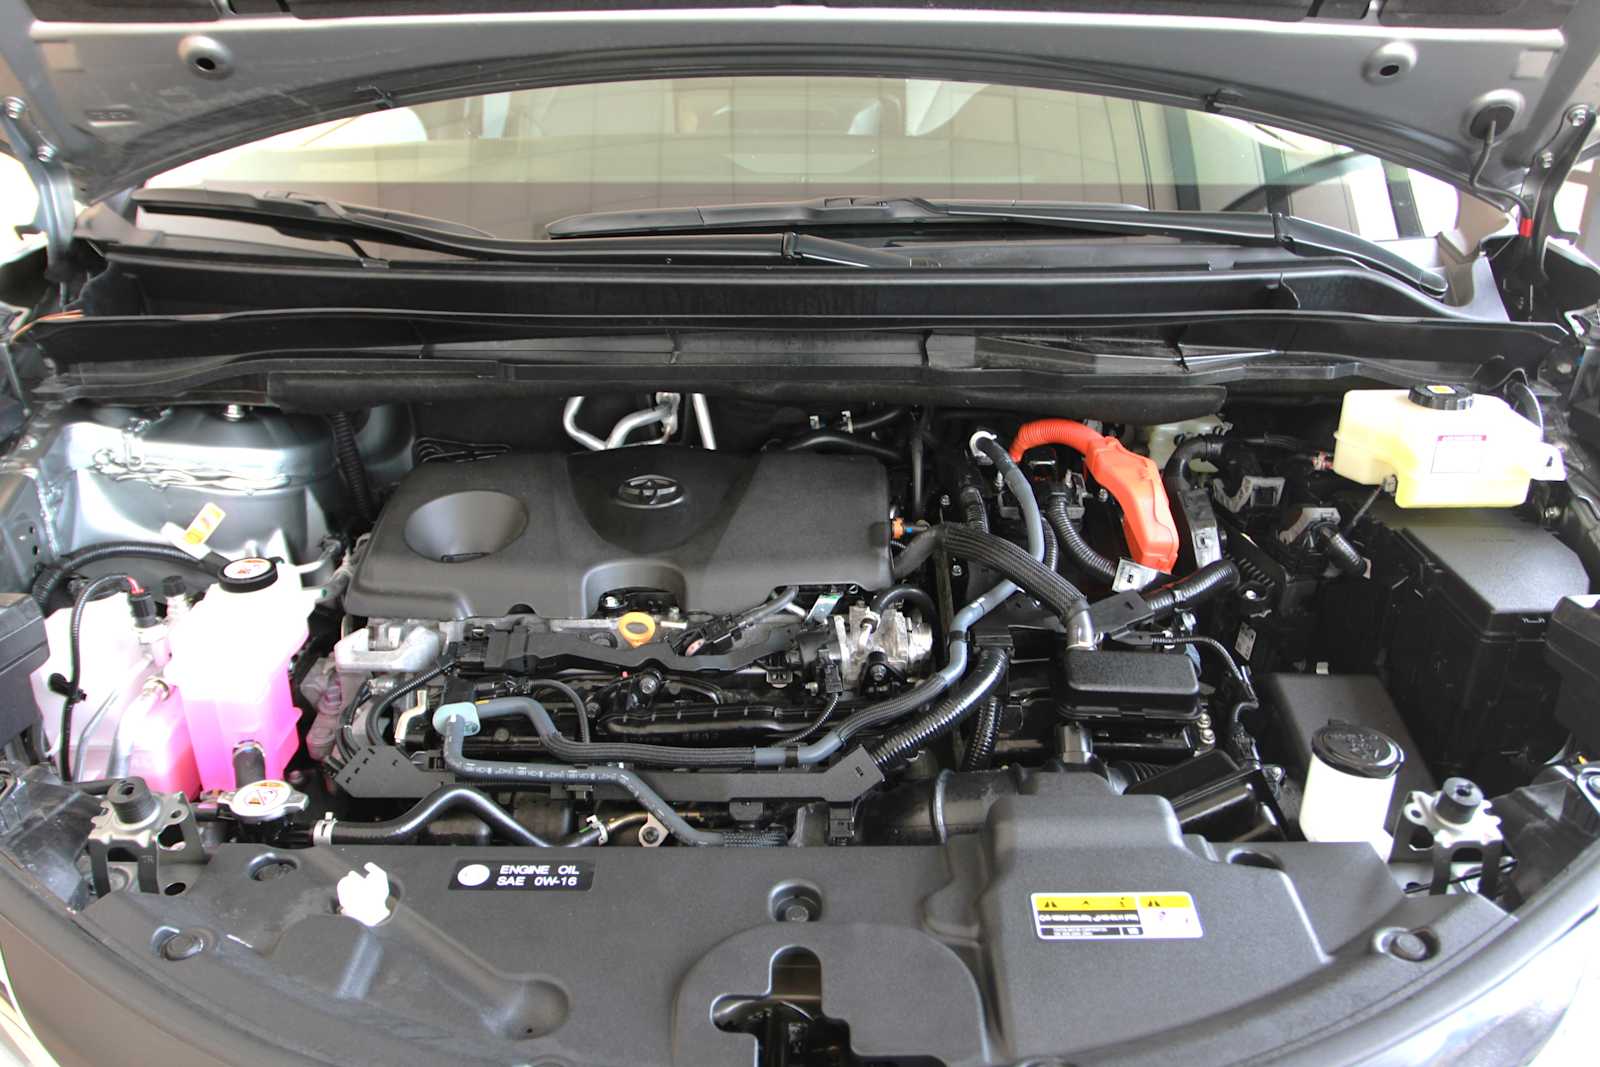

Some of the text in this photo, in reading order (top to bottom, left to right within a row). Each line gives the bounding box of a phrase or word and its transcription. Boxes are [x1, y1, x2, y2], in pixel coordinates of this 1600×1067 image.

[500, 865, 580, 875] ENGINE OIL
[496, 876, 578, 886] SAE 0W-16
